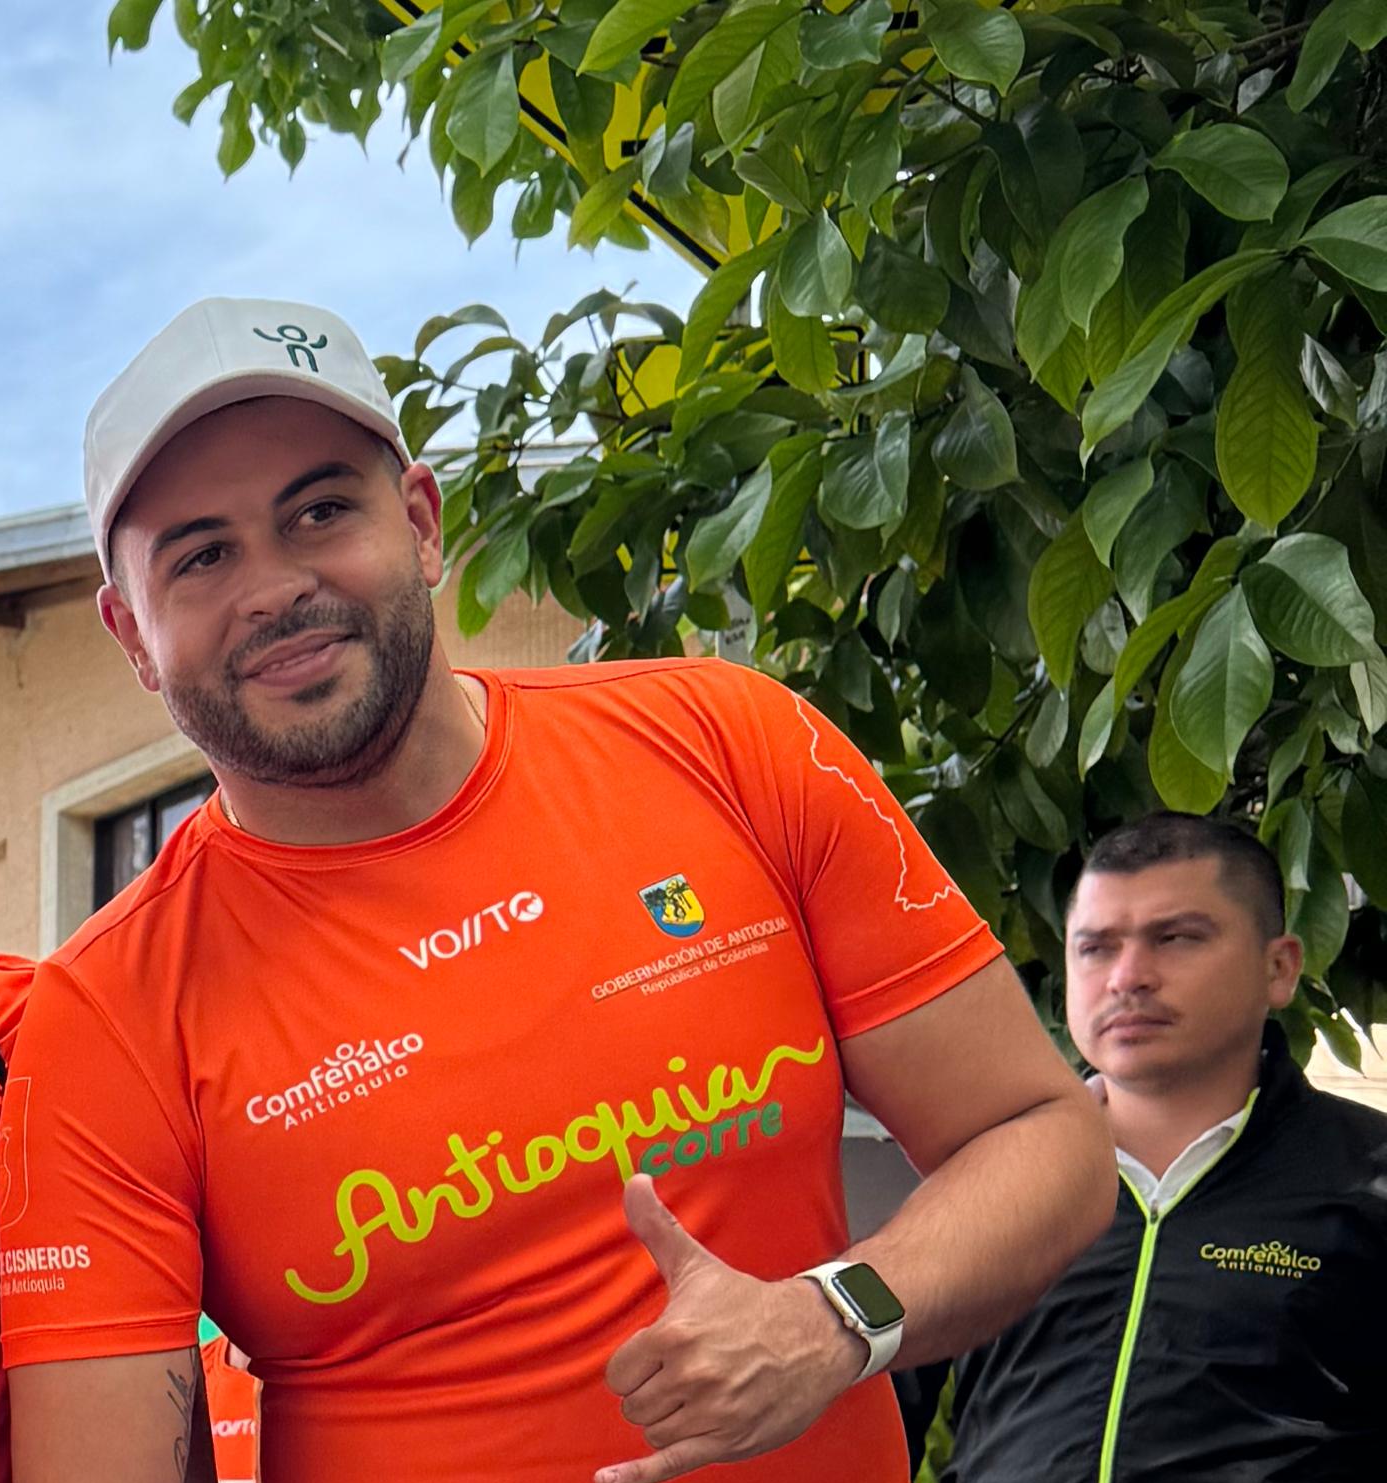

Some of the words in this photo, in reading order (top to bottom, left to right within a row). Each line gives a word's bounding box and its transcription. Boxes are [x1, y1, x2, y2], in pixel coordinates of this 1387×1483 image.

[703, 936, 726, 954] DE
[246, 1033, 424, 1124] Comfenalco
[285, 1064, 409, 1131] Antioquia
[639, 1101, 784, 1178] corre
[285, 1037, 825, 1305] Antioquia
[5, 1244, 91, 1274] CISNEROS
[1200, 1241, 1321, 1272] Comfenalco
[1216, 1258, 1303, 1279] Antioquia
